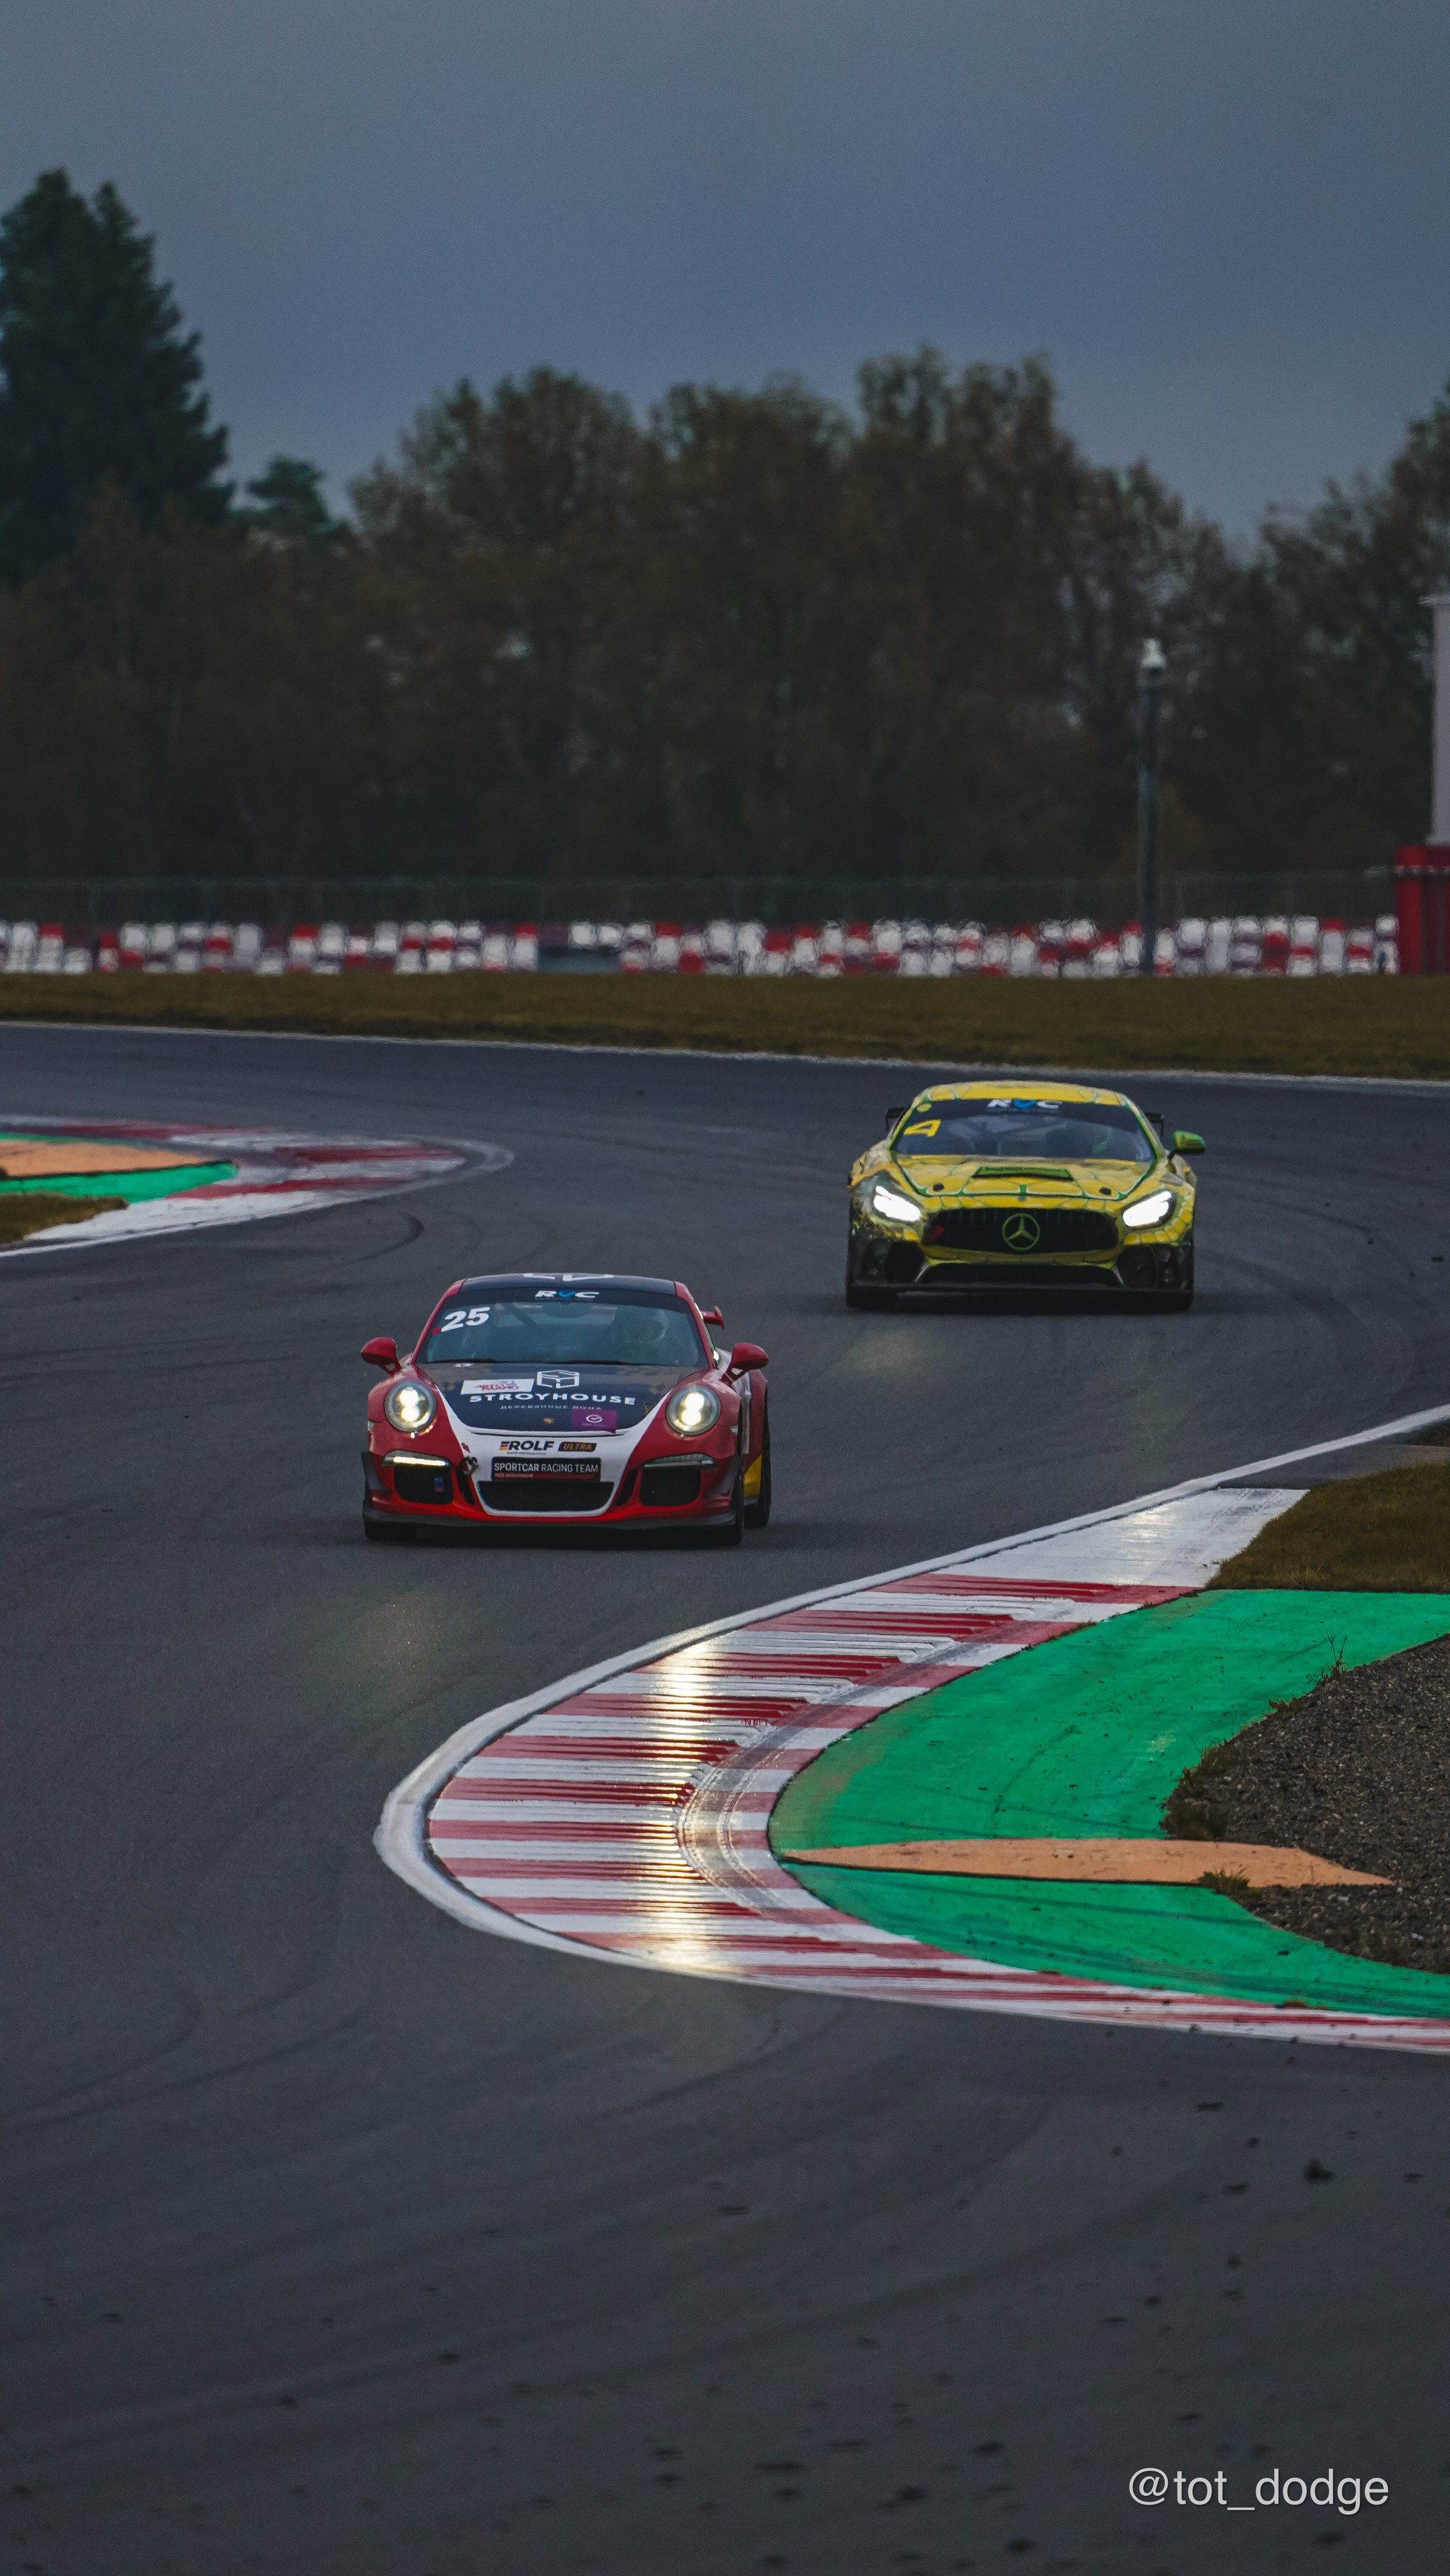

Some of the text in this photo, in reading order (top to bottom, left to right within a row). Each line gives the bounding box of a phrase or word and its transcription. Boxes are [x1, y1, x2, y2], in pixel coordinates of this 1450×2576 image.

[903, 1119, 942, 1138] 4
[441, 1306, 491, 1332] 25
[469, 1392, 636, 1405] STROYHOUSE
[508, 1440, 592, 1451] ROLF ULTRA
[494, 1462, 599, 1473] SPORTCAR RACING TEAM
